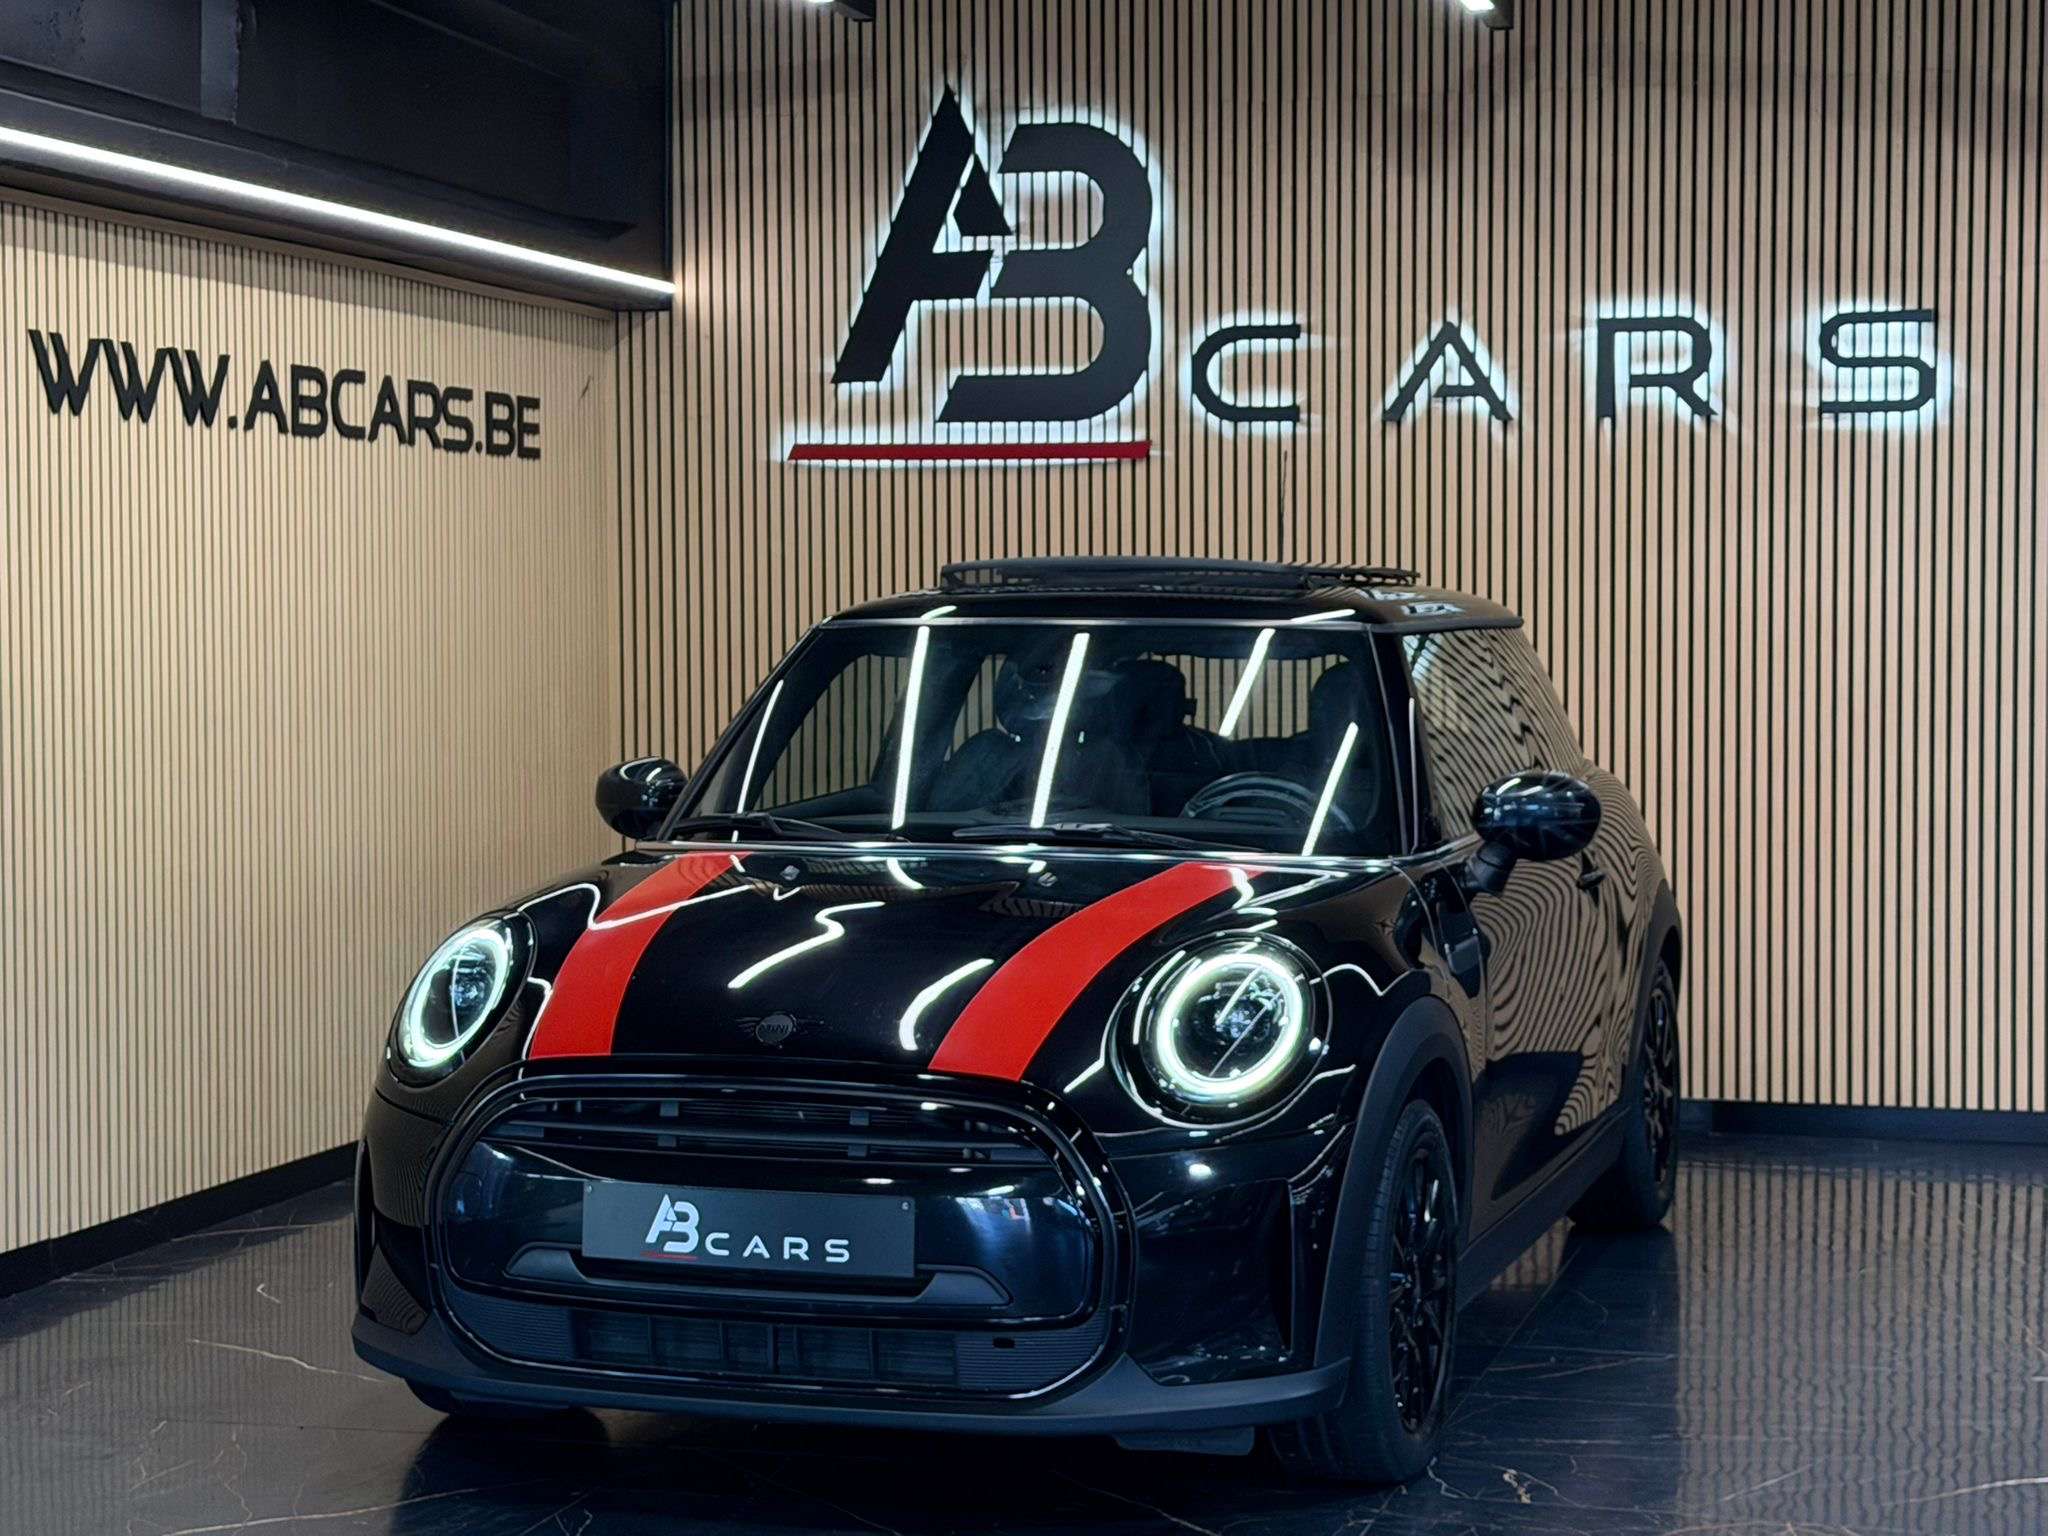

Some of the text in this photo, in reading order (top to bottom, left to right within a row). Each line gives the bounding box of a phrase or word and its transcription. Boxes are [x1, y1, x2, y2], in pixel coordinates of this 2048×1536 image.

[830, 84, 1936, 423] AB CARS
[28, 328, 541, 460] WWW.ABCARS.BE
[645, 1194, 850, 1263] AB CARS
